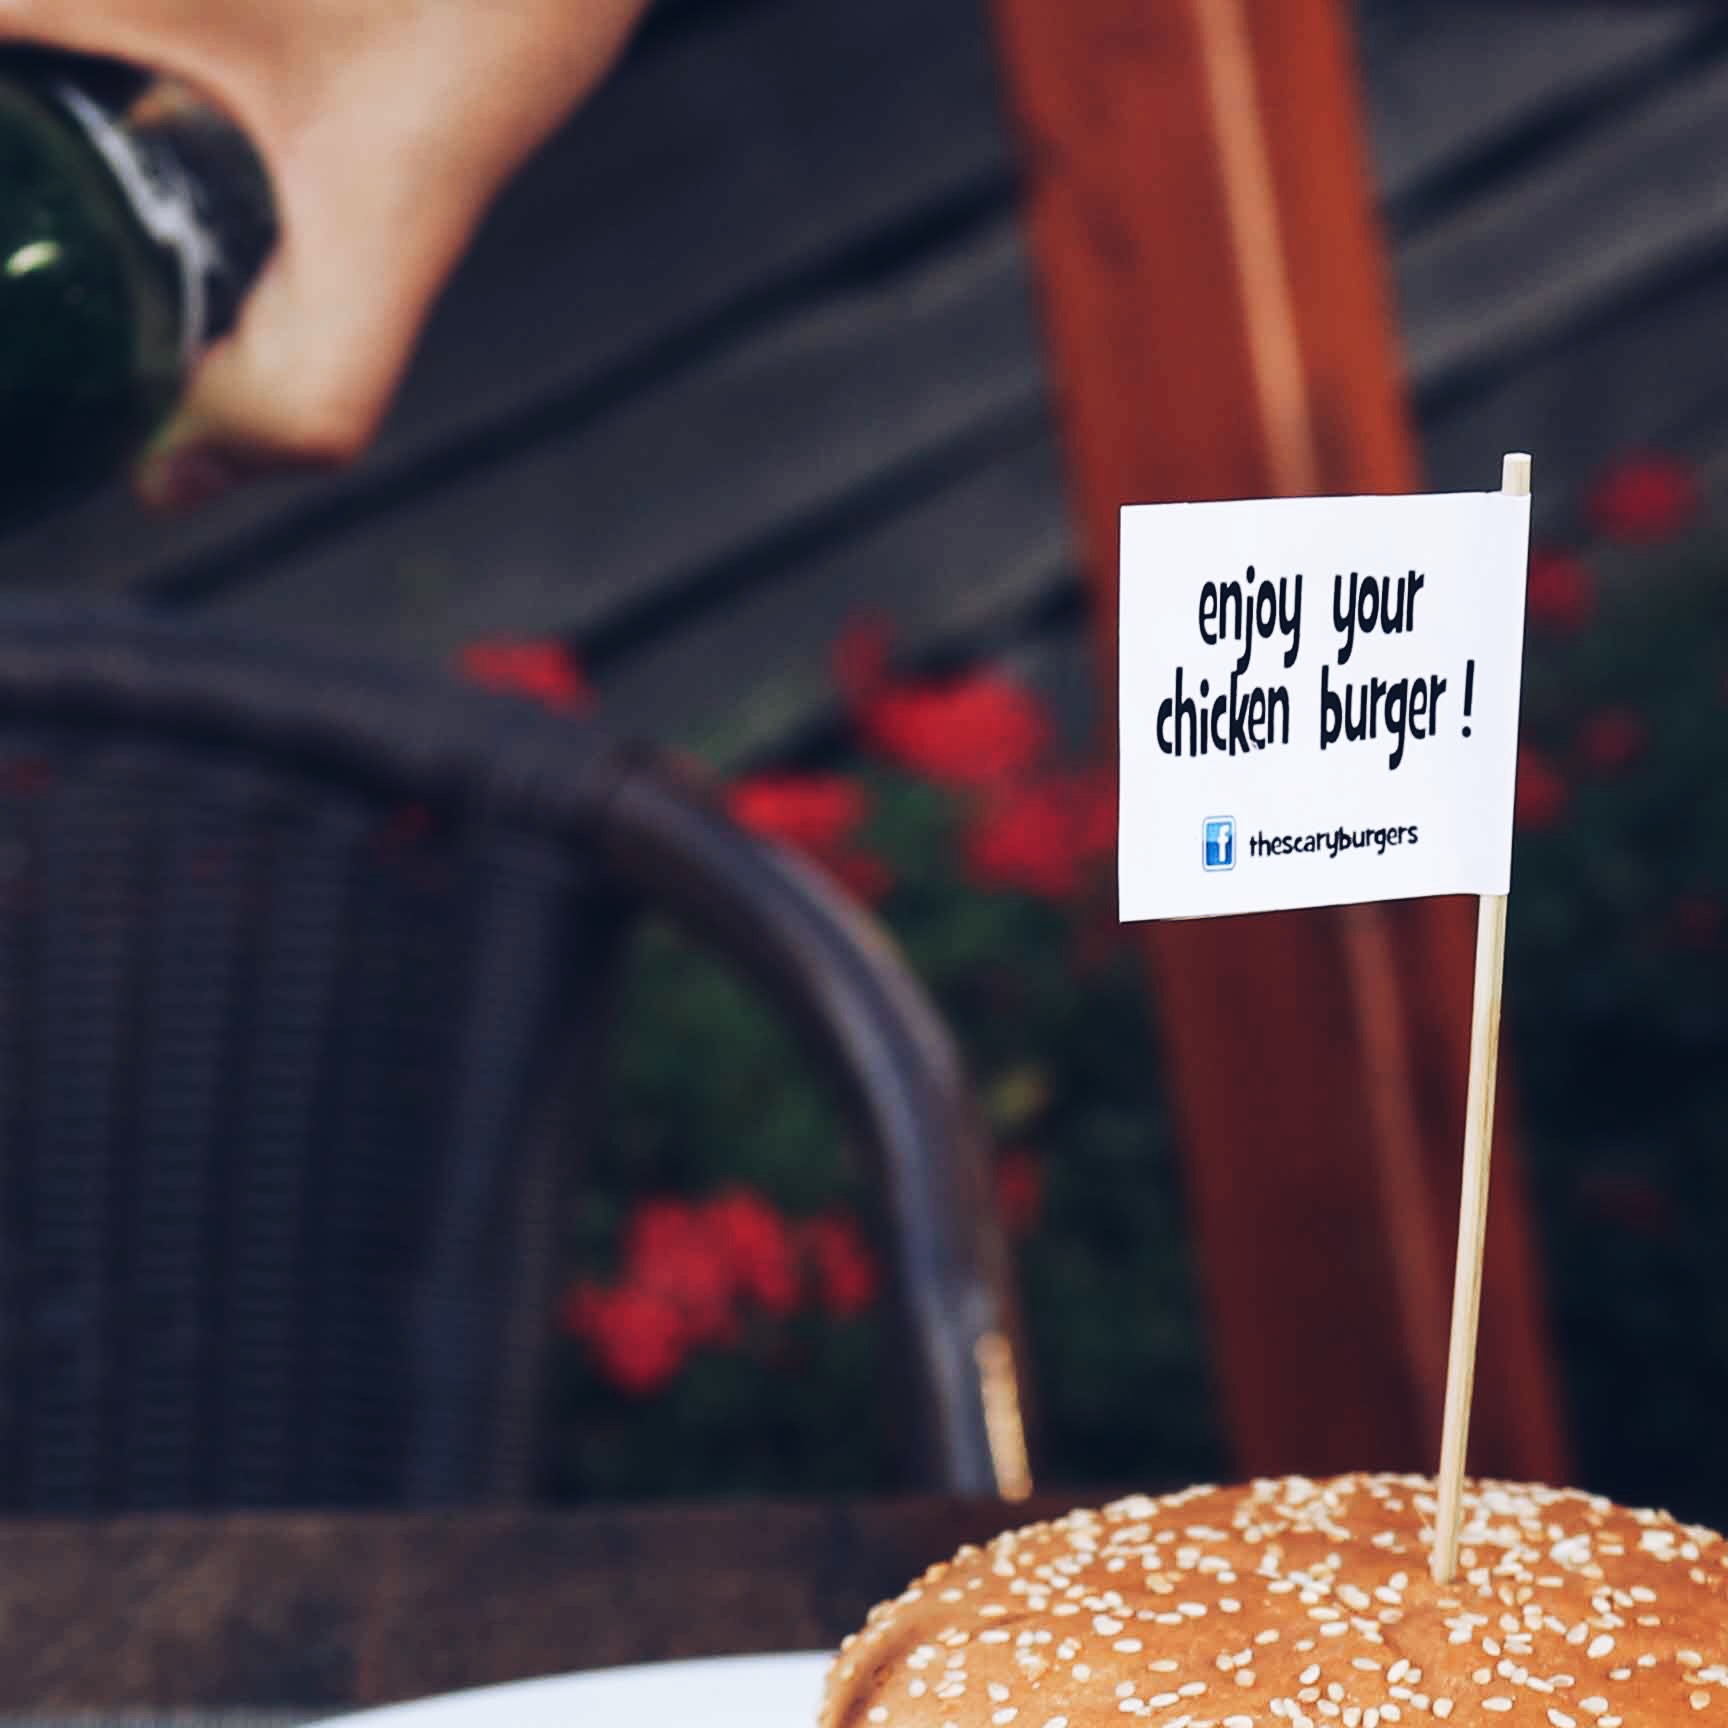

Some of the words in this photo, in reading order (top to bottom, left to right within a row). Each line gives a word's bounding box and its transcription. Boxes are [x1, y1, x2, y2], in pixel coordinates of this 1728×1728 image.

[1199, 565, 1303, 676] enjoy
[1333, 570, 1425, 665] your
[1157, 666, 1290, 757] chicken
[1249, 825, 1419, 858] thescaryburgers
